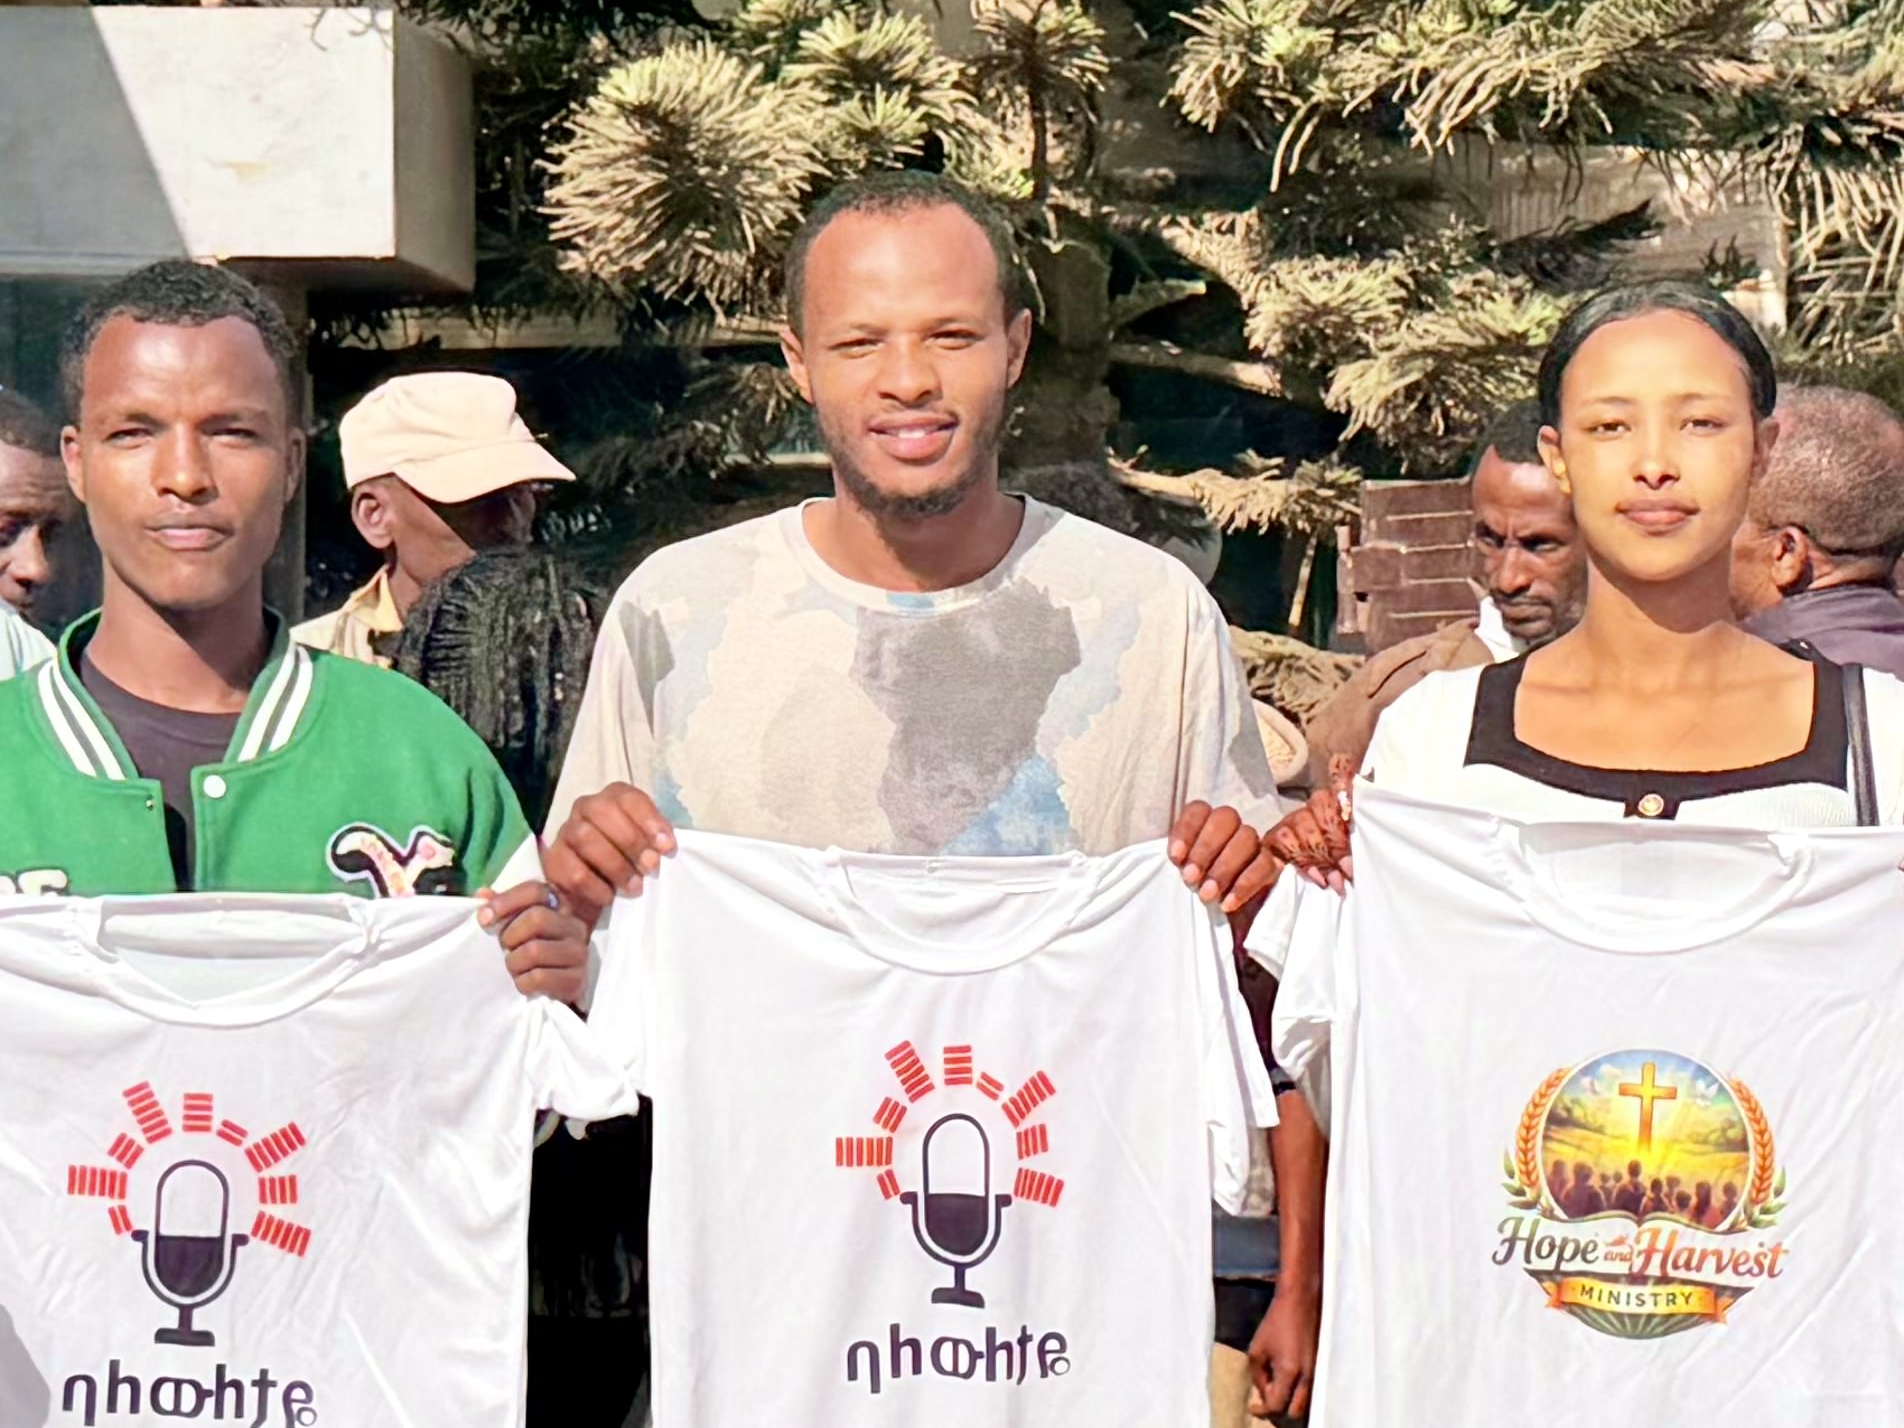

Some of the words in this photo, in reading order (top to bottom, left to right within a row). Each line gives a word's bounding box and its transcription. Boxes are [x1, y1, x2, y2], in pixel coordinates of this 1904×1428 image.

[1492, 1215, 1600, 1271] Hope
[1603, 1242, 1633, 1264] and
[1629, 1226, 1790, 1280] Harvest
[1579, 1282, 1695, 1308] MINISTRY
